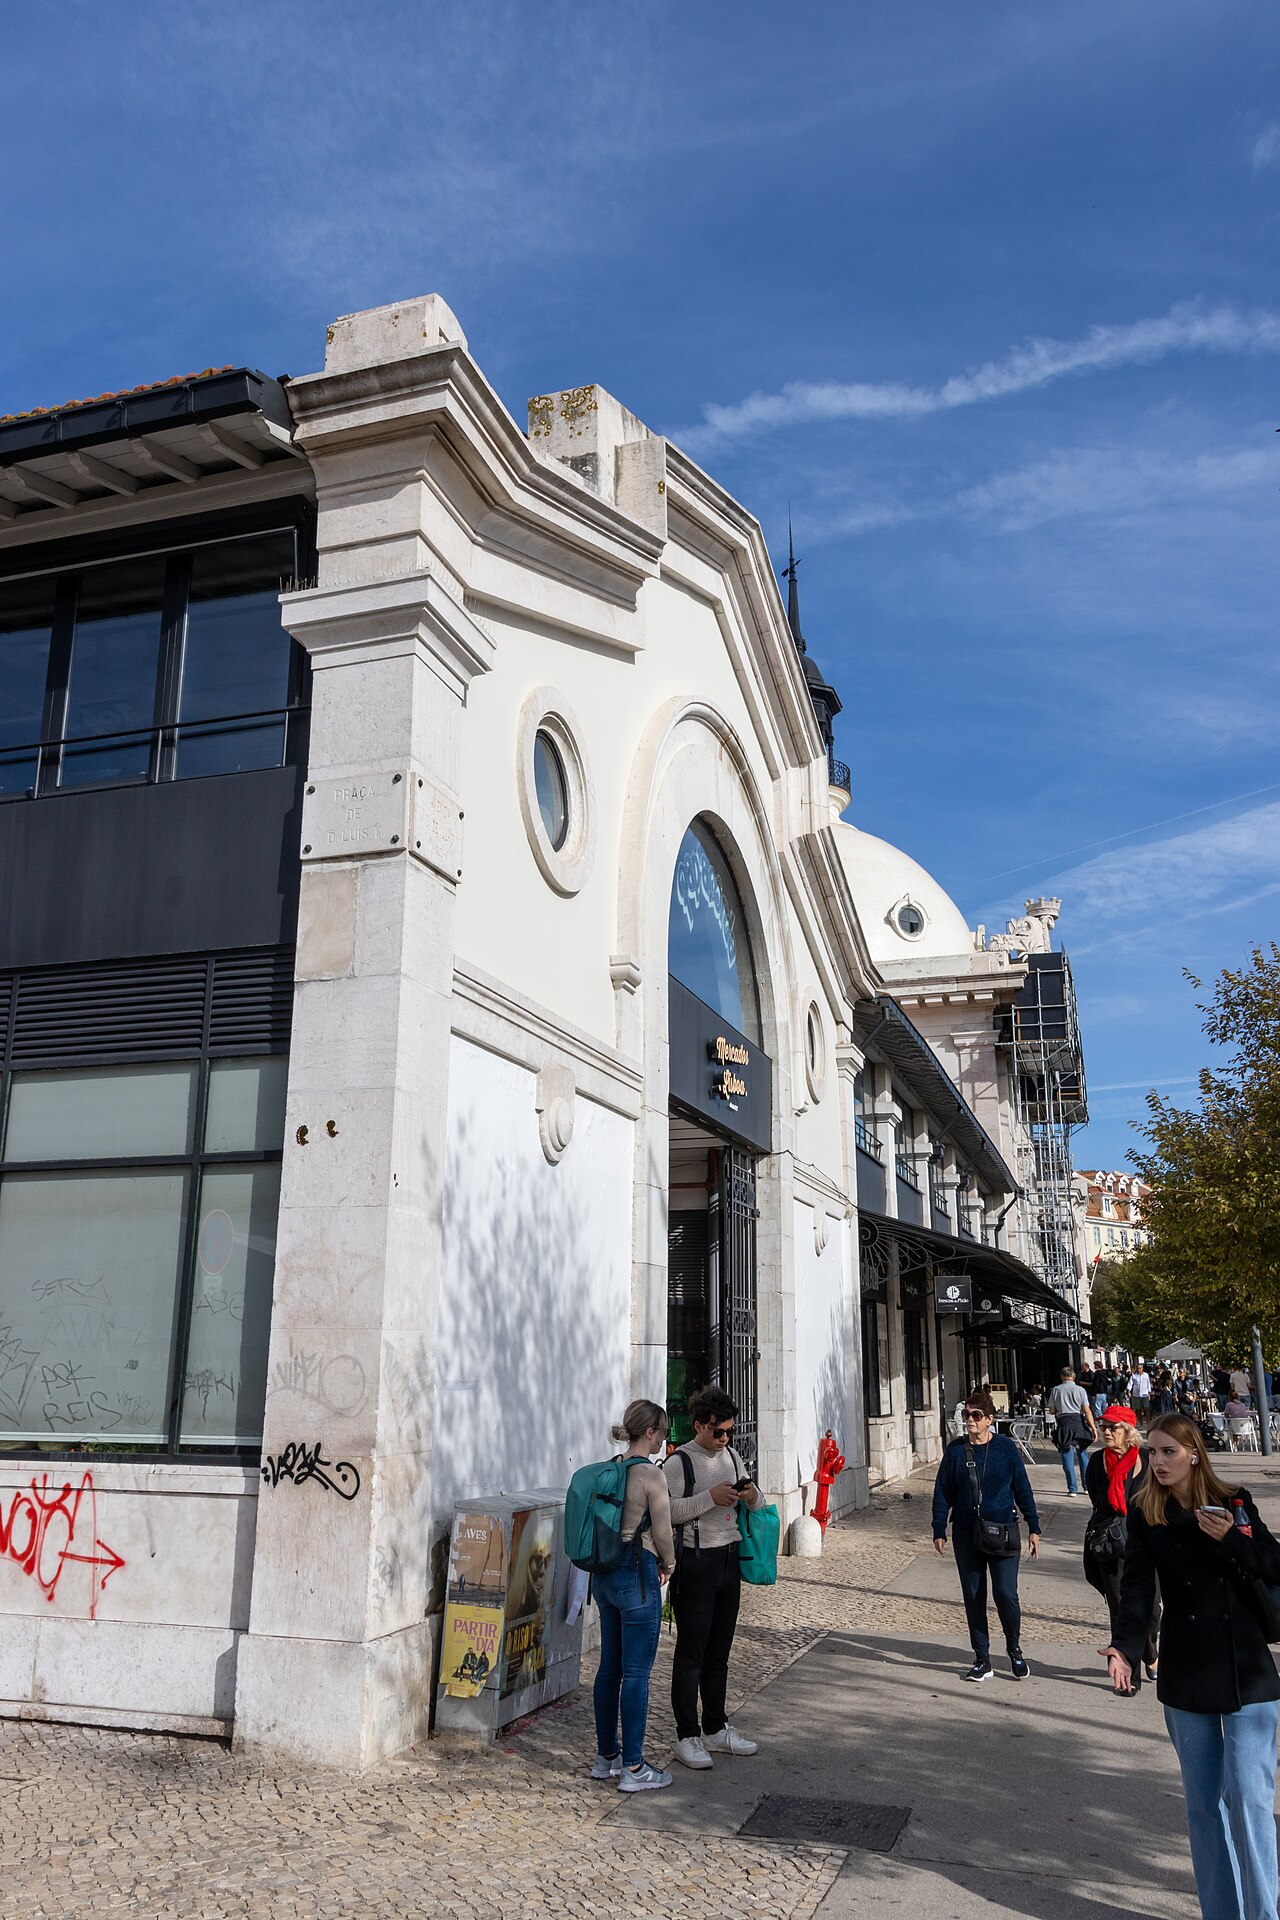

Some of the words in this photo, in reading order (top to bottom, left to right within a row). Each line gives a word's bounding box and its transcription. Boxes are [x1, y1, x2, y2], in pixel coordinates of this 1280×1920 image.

[334, 786, 375, 802] PRAÇA
[346, 807, 362, 821] DE
[42, 1390, 123, 1433] REIS
[463, 1527, 488, 1541] AVES
[475, 1637, 495, 1654] DIA
[505, 1631, 512, 1656] O
[512, 1624, 530, 1654] RISO
[530, 1623, 536, 1647] E
